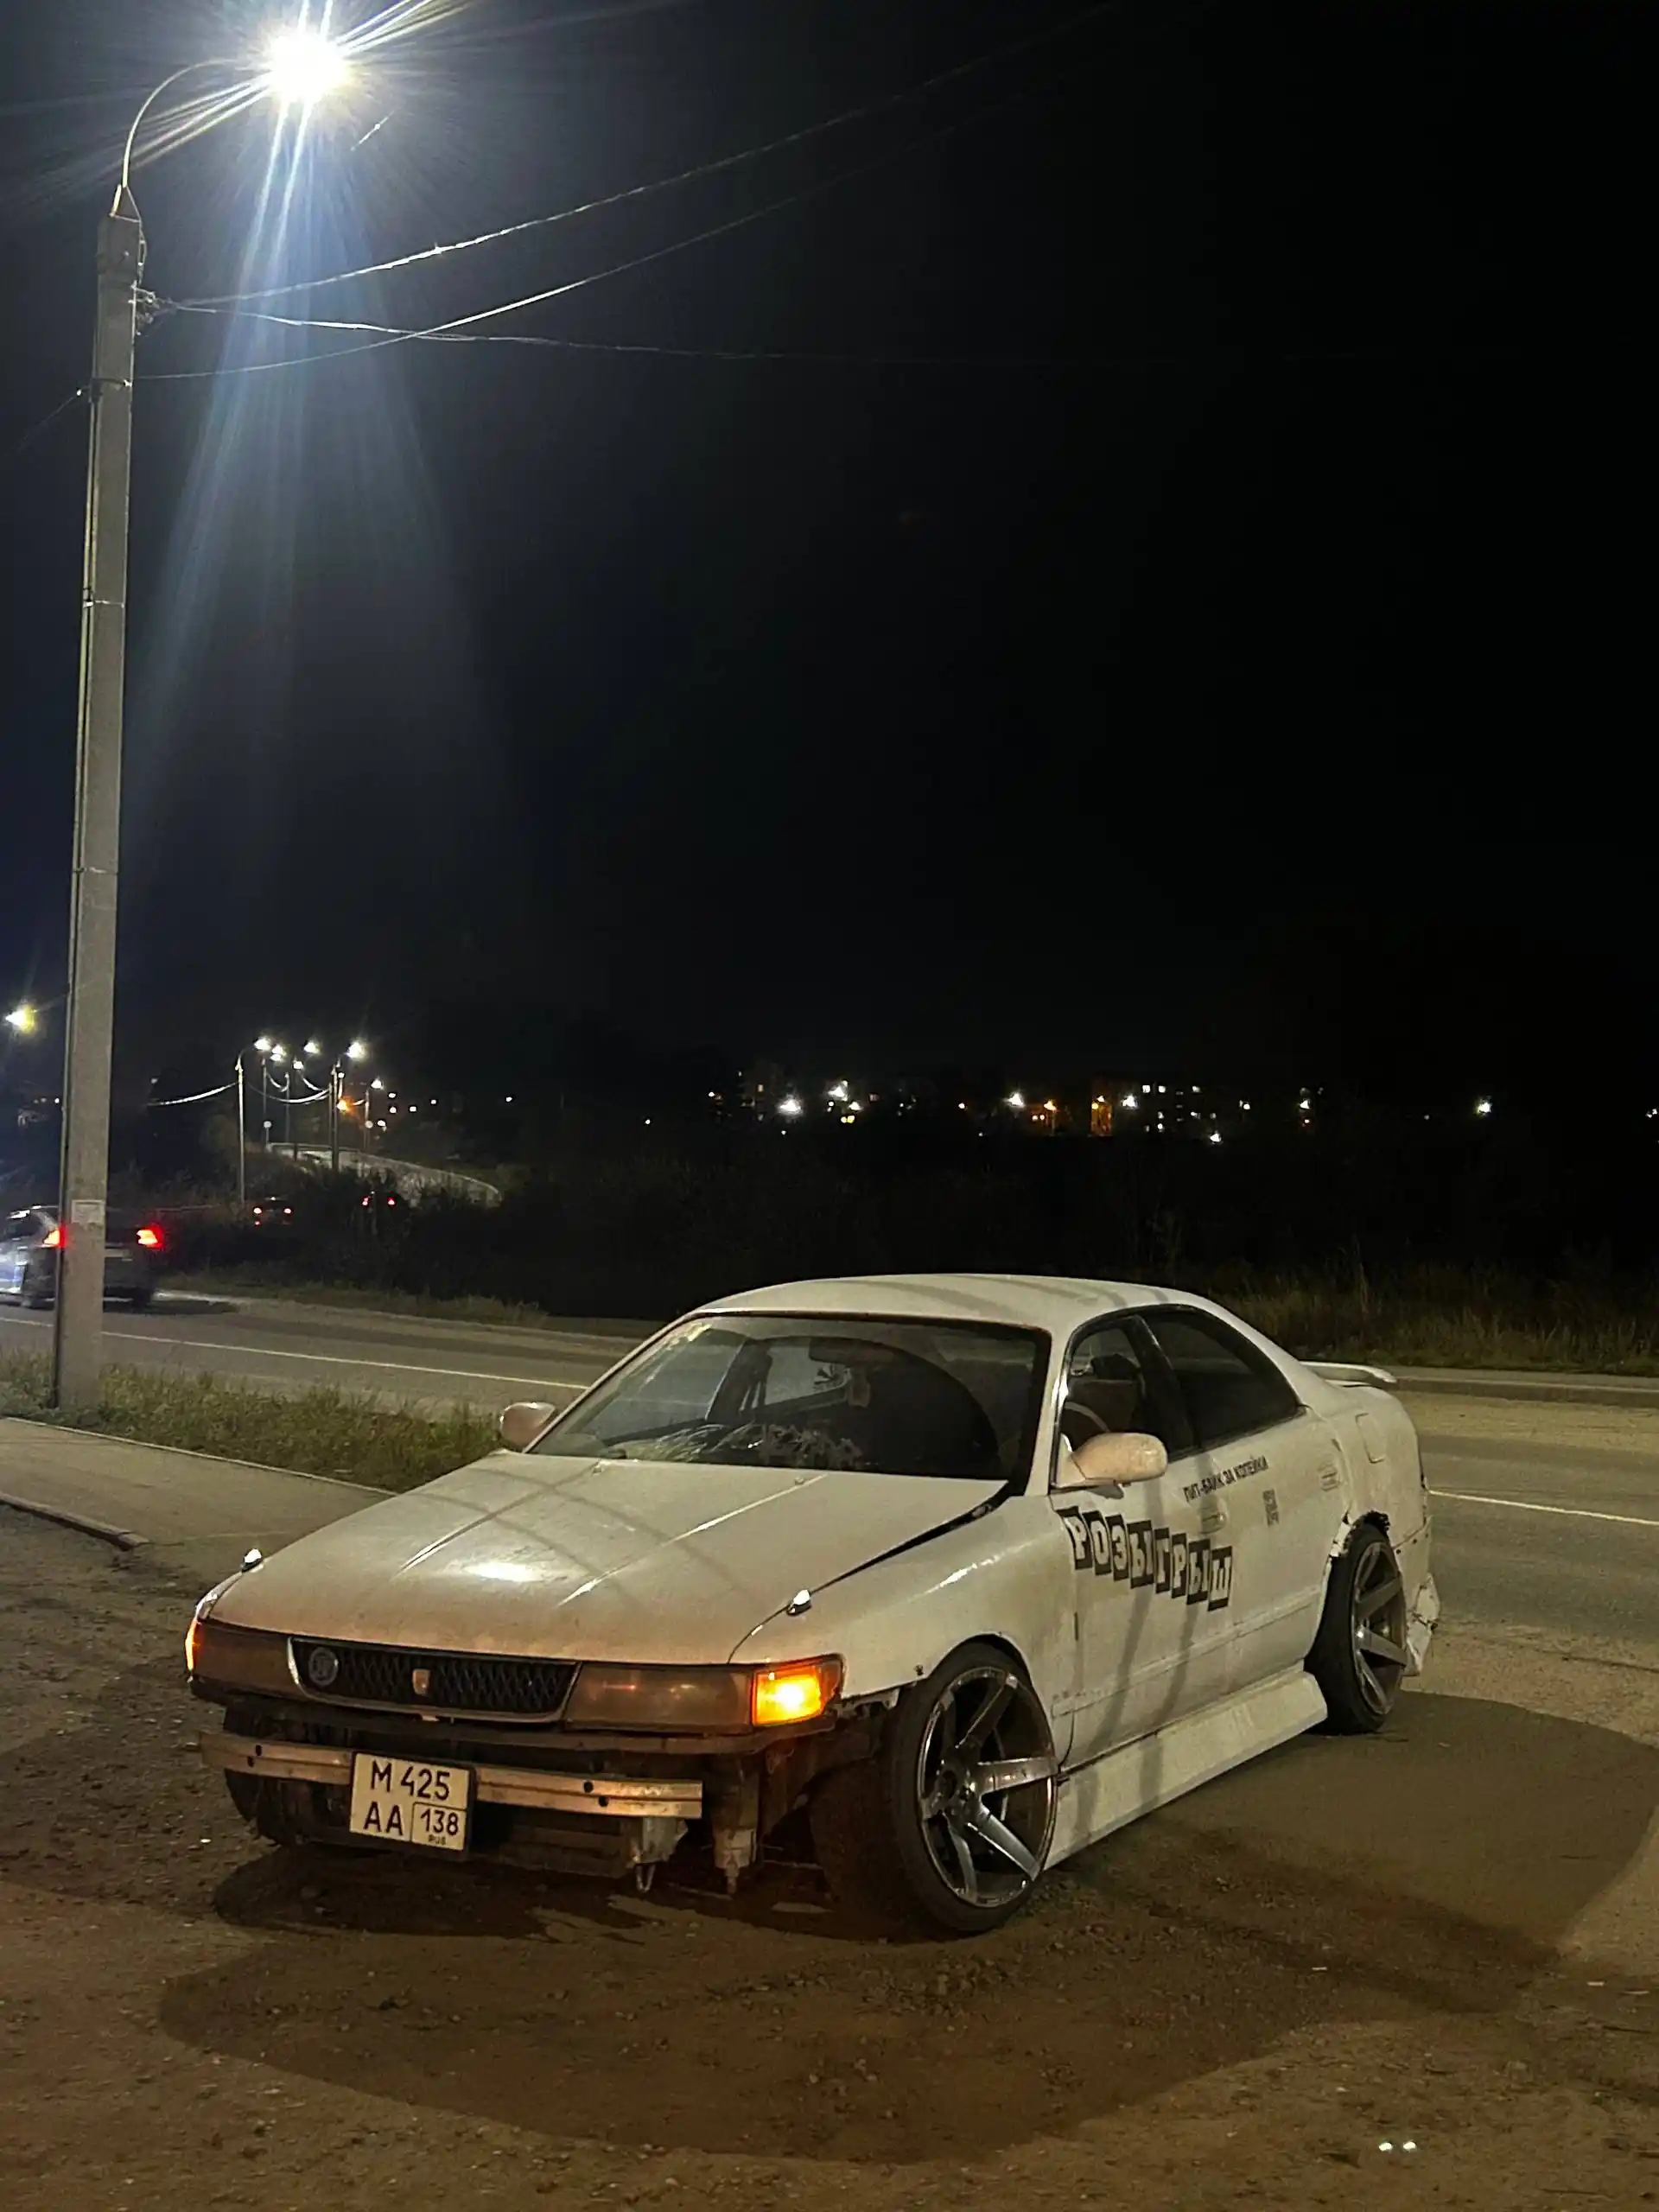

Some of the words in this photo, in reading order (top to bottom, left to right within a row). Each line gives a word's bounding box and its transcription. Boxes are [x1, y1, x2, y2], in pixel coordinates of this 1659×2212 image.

[1222, 1469, 1236, 1484] ЗА
[1060, 1512, 1233, 1604] РОЗЫГРЫШ
[400, 1765, 450, 1801] 425
[362, 1801, 404, 1836] АА
[420, 1808, 459, 1836] 138
